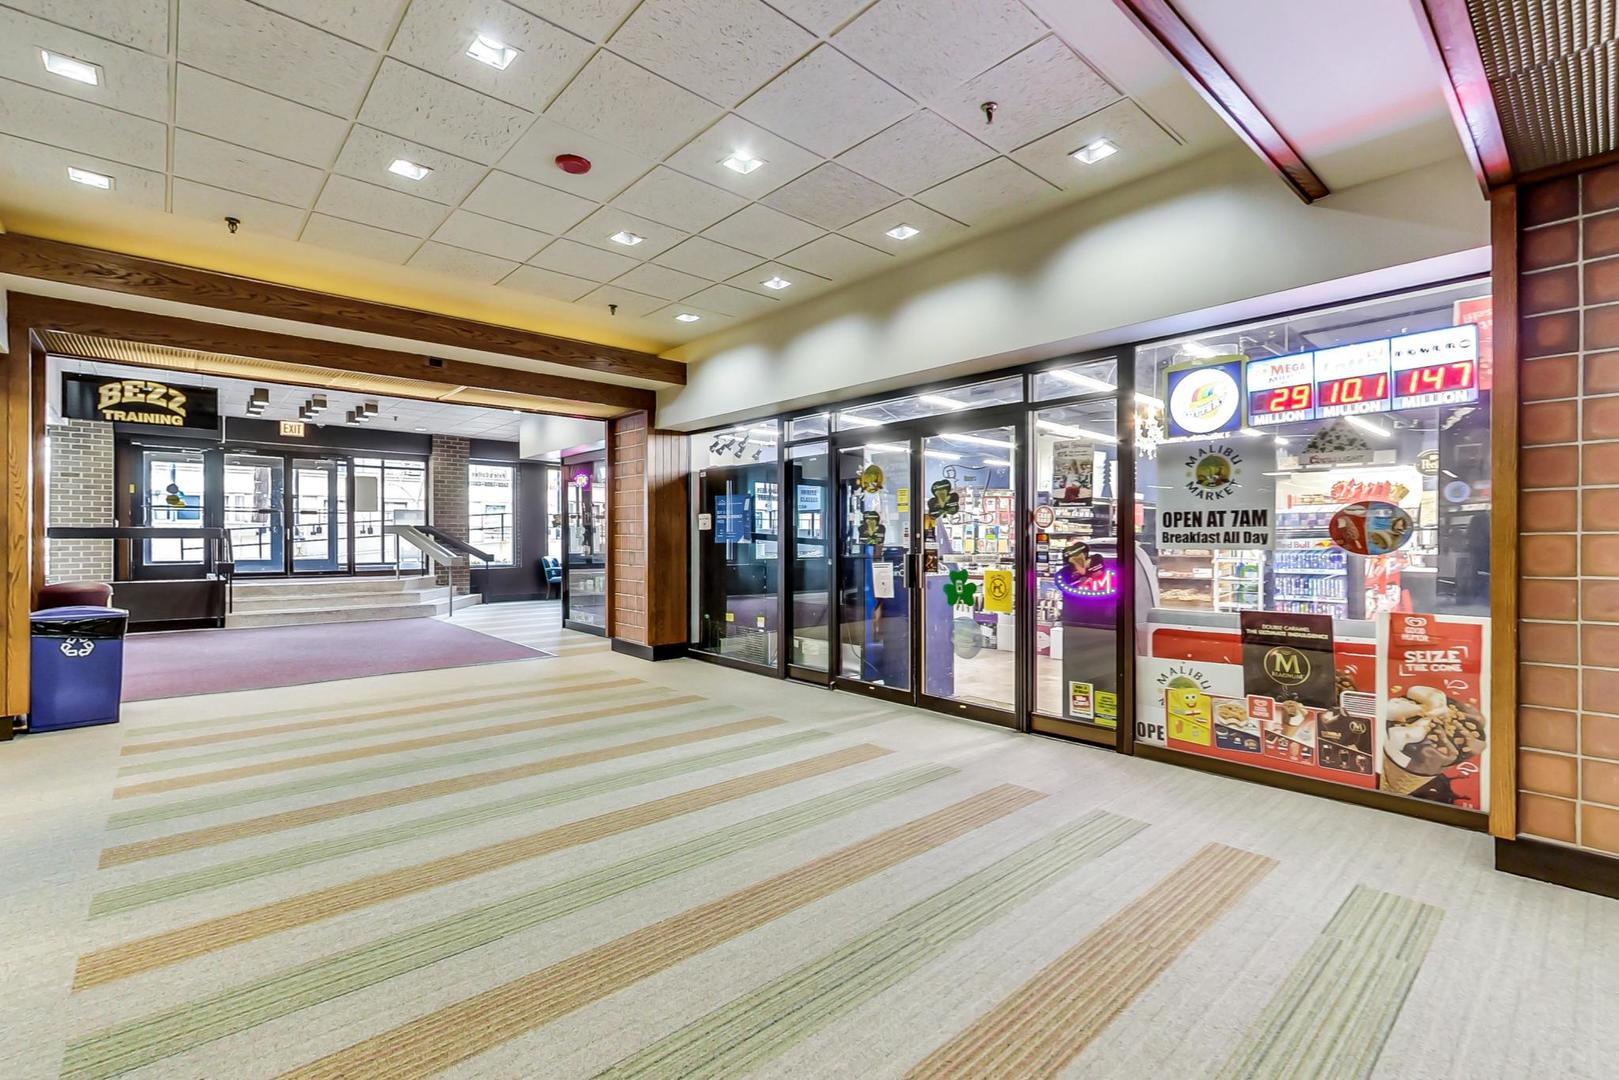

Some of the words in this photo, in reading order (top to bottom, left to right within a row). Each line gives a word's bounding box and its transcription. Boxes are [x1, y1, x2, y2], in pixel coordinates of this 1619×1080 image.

[1270, 363, 1305, 376] MEGA
[1410, 362, 1472, 393] 147
[98, 380, 187, 418] BEZZ
[1270, 385, 1310, 412] 29
[1402, 390, 1468, 409] MILLION
[102, 409, 184, 427] TRAINING
[1254, 411, 1305, 426] MILLION
[1323, 402, 1382, 417] MILLION
[283, 424, 302, 434] EXIT
[1185, 445, 1243, 468] MALIBU
[1186, 478, 1241, 501] MARKET
[1163, 511, 1202, 528] OPEN
[1207, 510, 1227, 528] AT
[1231, 509, 1268, 527] 7AM
[1162, 531, 1221, 544] Breakfast
[1224, 531, 1239, 544] All
[1243, 531, 1268, 545] Day
[1404, 650, 1461, 663] SEIZE
[1430, 664, 1463, 672] CONE
[1156, 665, 1212, 691] MALIBU
